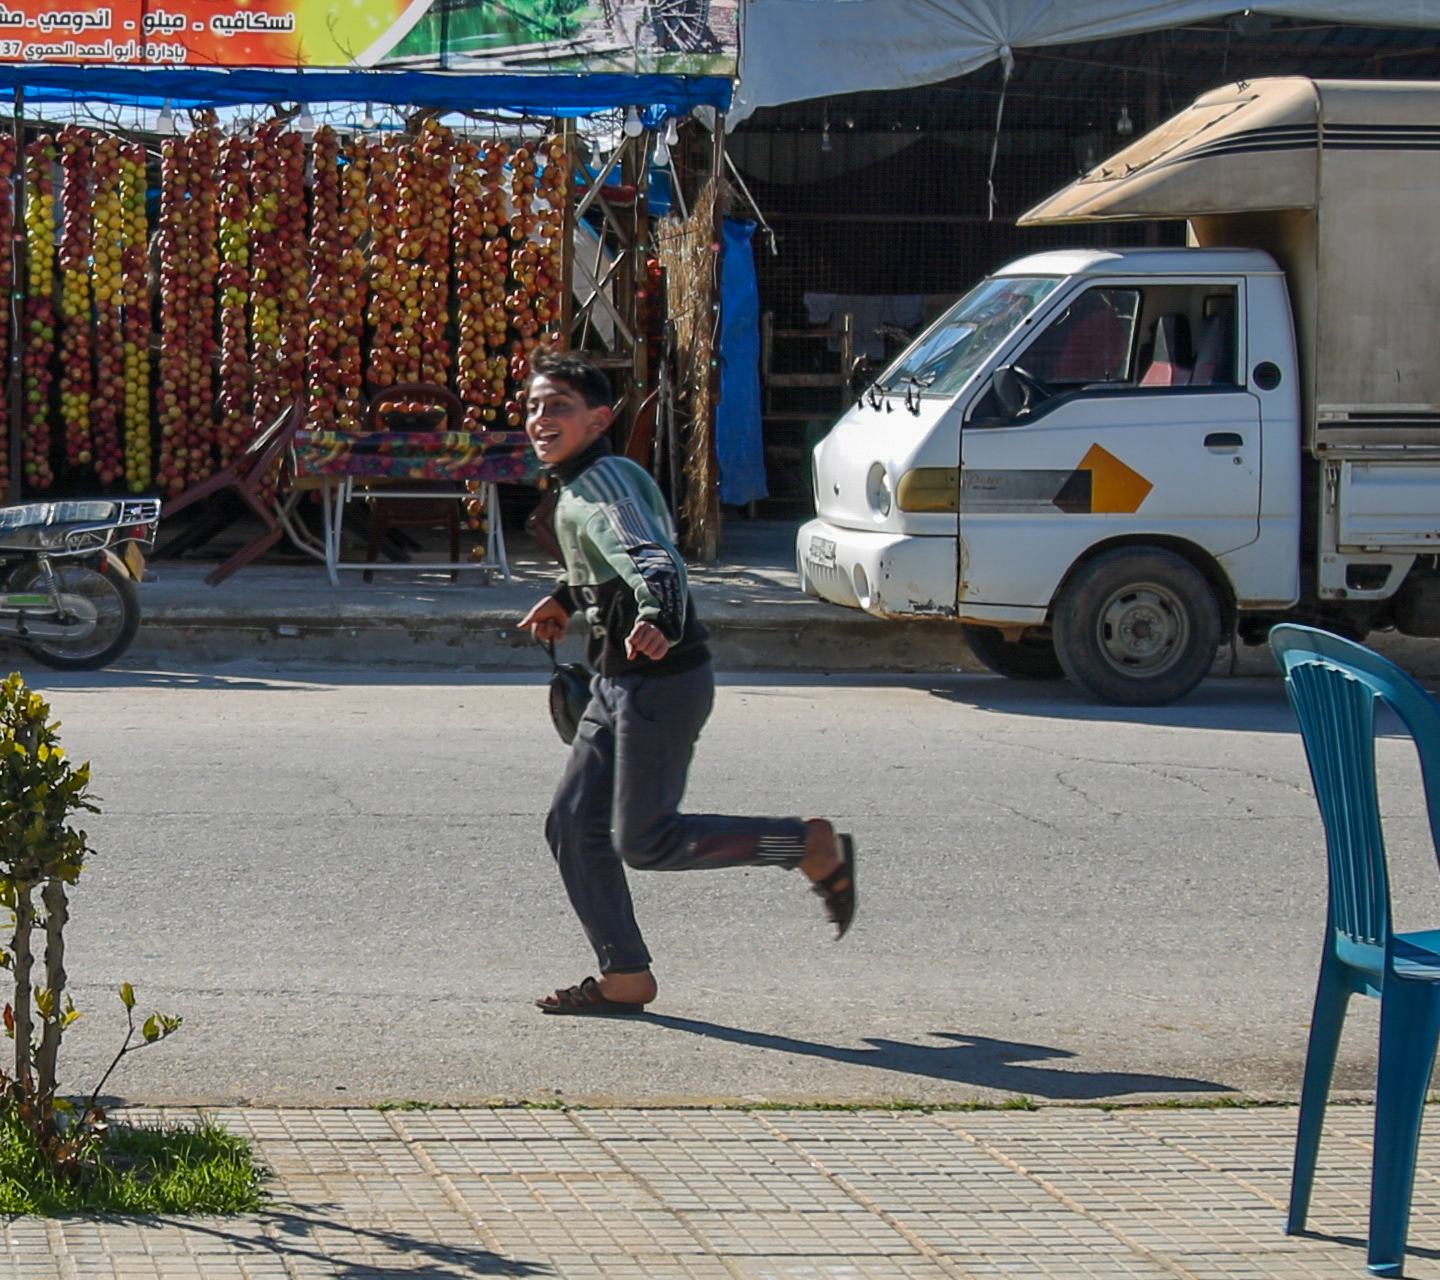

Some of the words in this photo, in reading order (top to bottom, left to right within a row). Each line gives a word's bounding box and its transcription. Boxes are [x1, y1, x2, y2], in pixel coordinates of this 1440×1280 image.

[39, 9, 111, 32] اندومي
[143, 11, 185, 34] ميلو
[211, 12, 296, 35] نسكافيه
[25, 42, 74, 61] الحموي
[77, 40, 110, 56] أحمد
[115, 41, 133, 61] أبو
